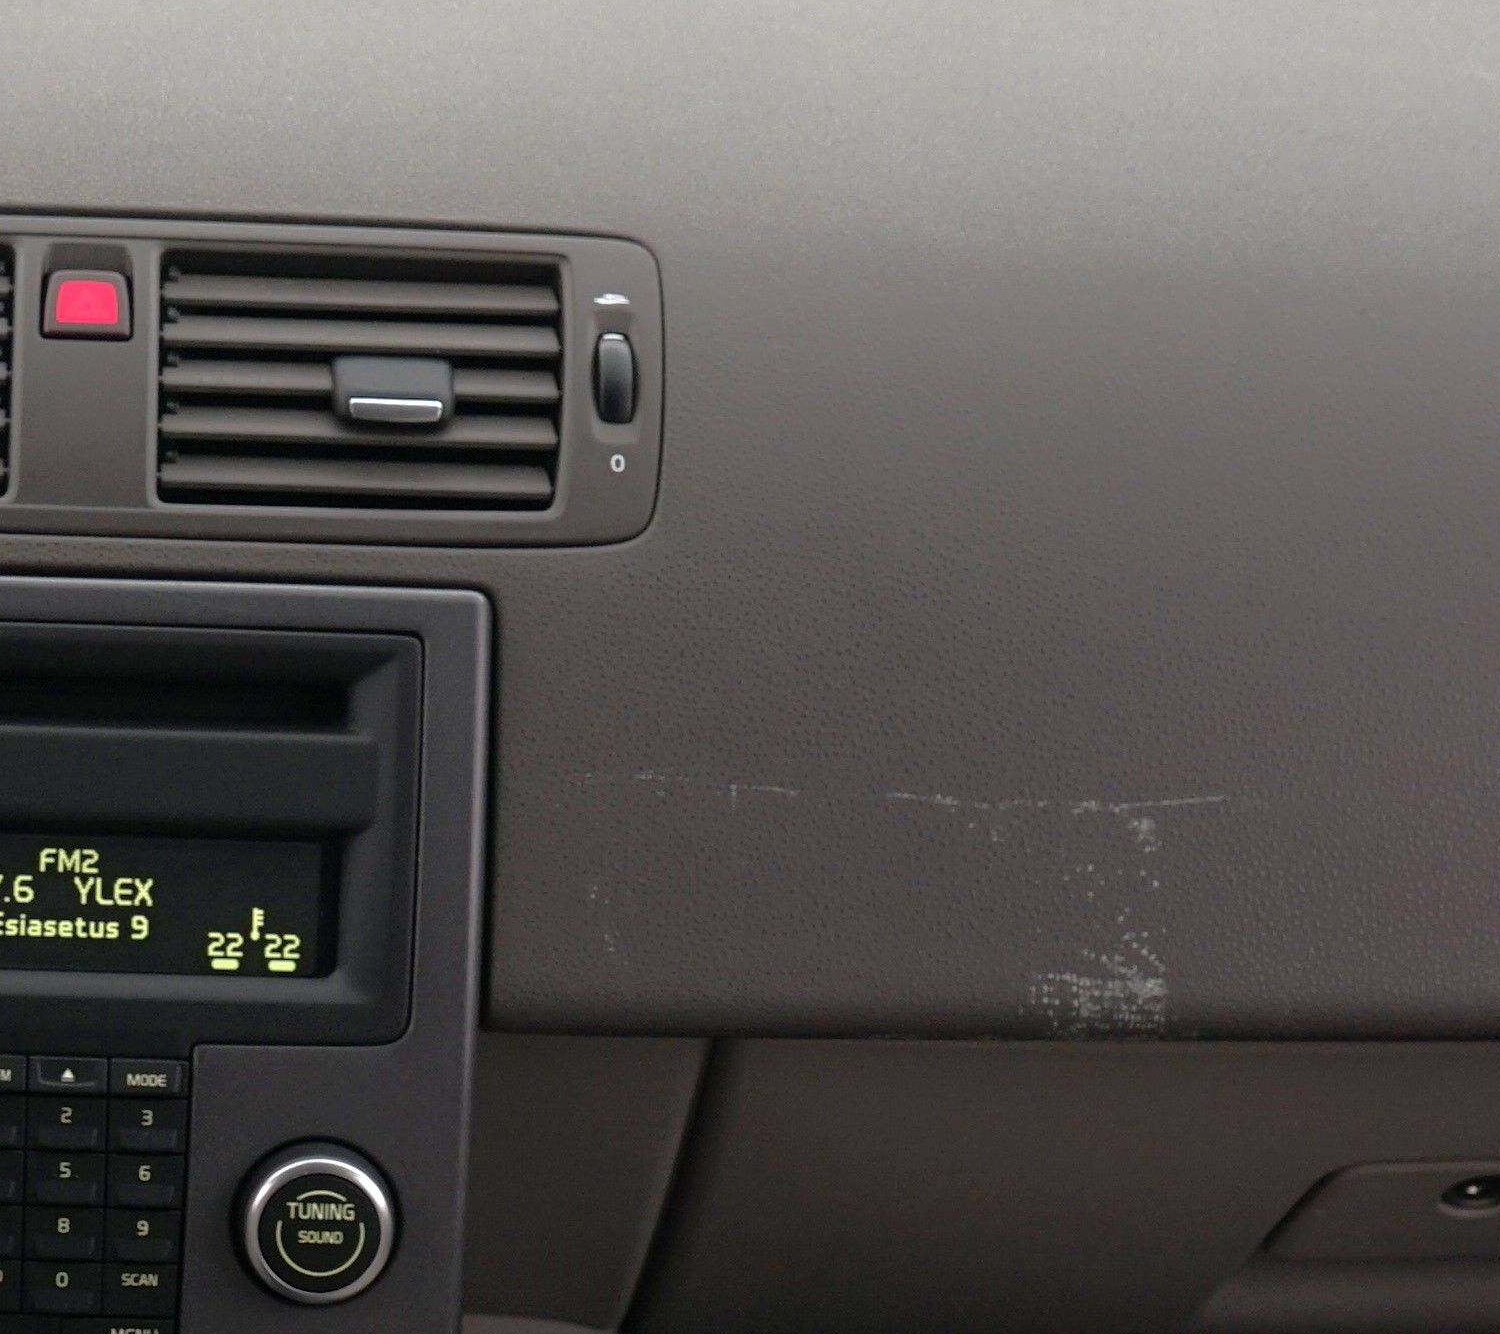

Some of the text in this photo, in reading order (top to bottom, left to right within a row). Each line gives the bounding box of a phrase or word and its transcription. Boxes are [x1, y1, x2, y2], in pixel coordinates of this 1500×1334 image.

[39, 847, 100, 874] FM2
[73, 876, 154, 907] YLEX
[130, 914, 149, 940] 9
[207, 932, 243, 957] 22
[264, 934, 300, 959] 22
[126, 1073, 167, 1088] MODE
[60, 1106, 73, 1124] 2
[141, 1109, 154, 1127] 3
[59, 1161, 72, 1179] 5
[138, 1165, 151, 1182] 6
[286, 1202, 356, 1223] TUNING
[57, 1217, 71, 1234] 8
[136, 1219, 150, 1236] 9
[297, 1229, 344, 1245] SOUND
[55, 1271, 69, 1288] 0
[120, 1272, 159, 1287] SCAN
